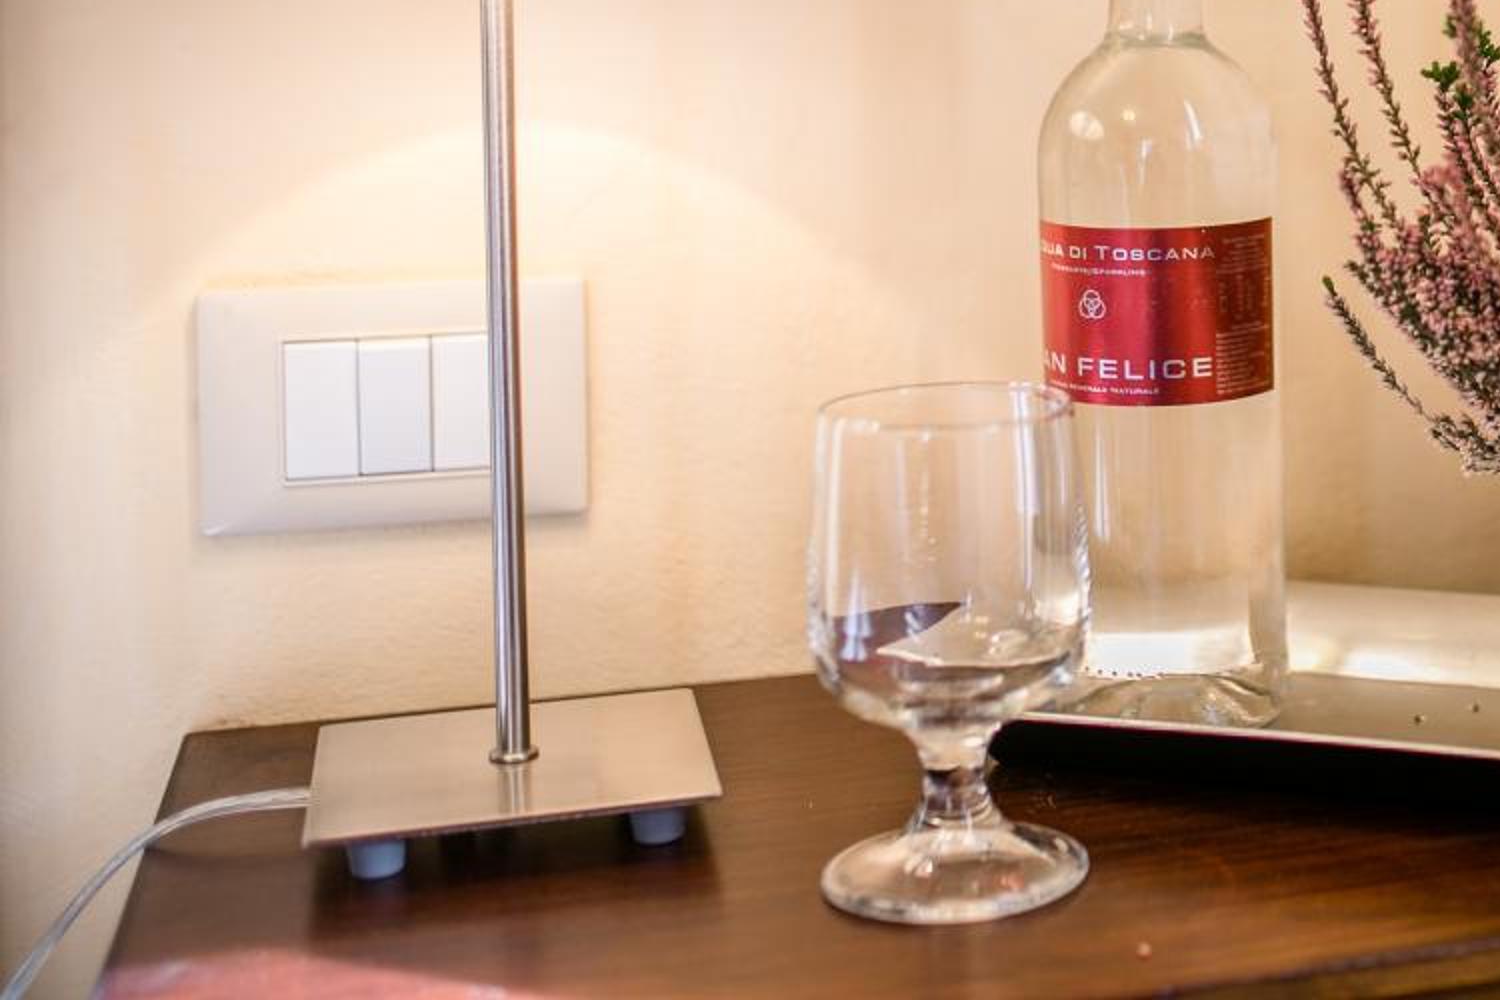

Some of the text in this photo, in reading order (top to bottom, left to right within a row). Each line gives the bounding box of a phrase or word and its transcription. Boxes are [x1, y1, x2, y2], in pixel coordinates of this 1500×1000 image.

[1069, 245, 1088, 261] DI
[1093, 245, 1216, 262] TOSCANA
[1077, 356, 1213, 381] FELICE
